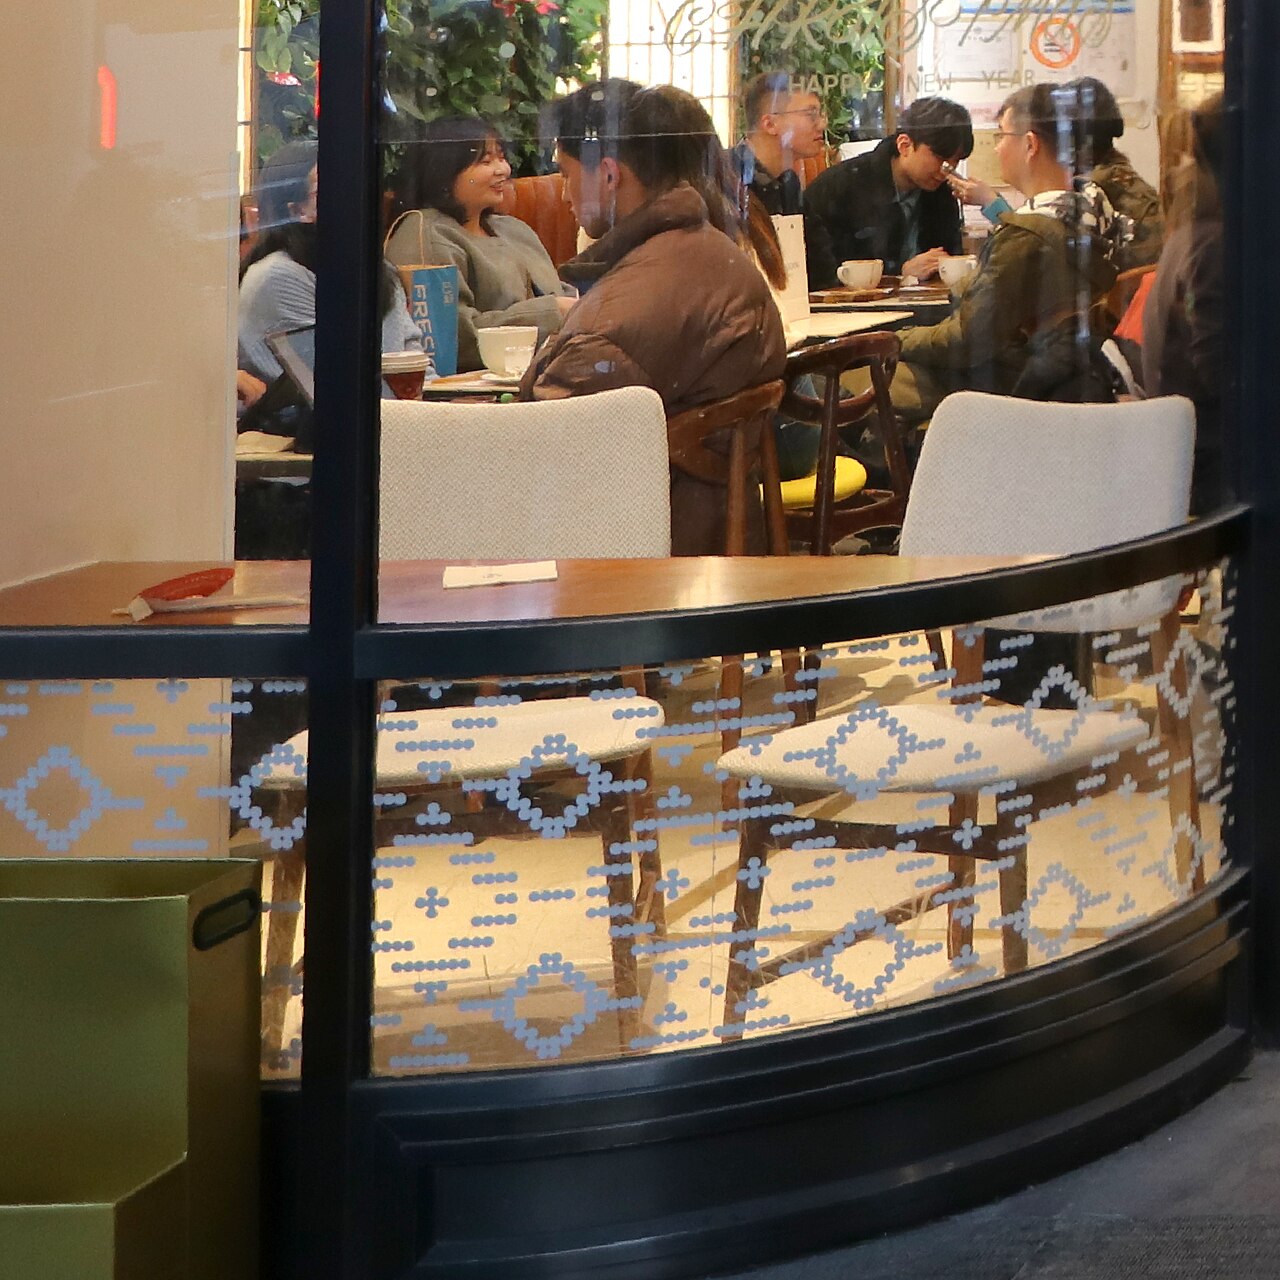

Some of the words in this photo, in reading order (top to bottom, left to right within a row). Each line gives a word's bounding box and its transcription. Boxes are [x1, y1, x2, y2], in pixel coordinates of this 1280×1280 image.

[789, 72, 871, 97] HAPPY
[906, 73, 953, 93] NEW
[982, 68, 1036, 91] YEAR
